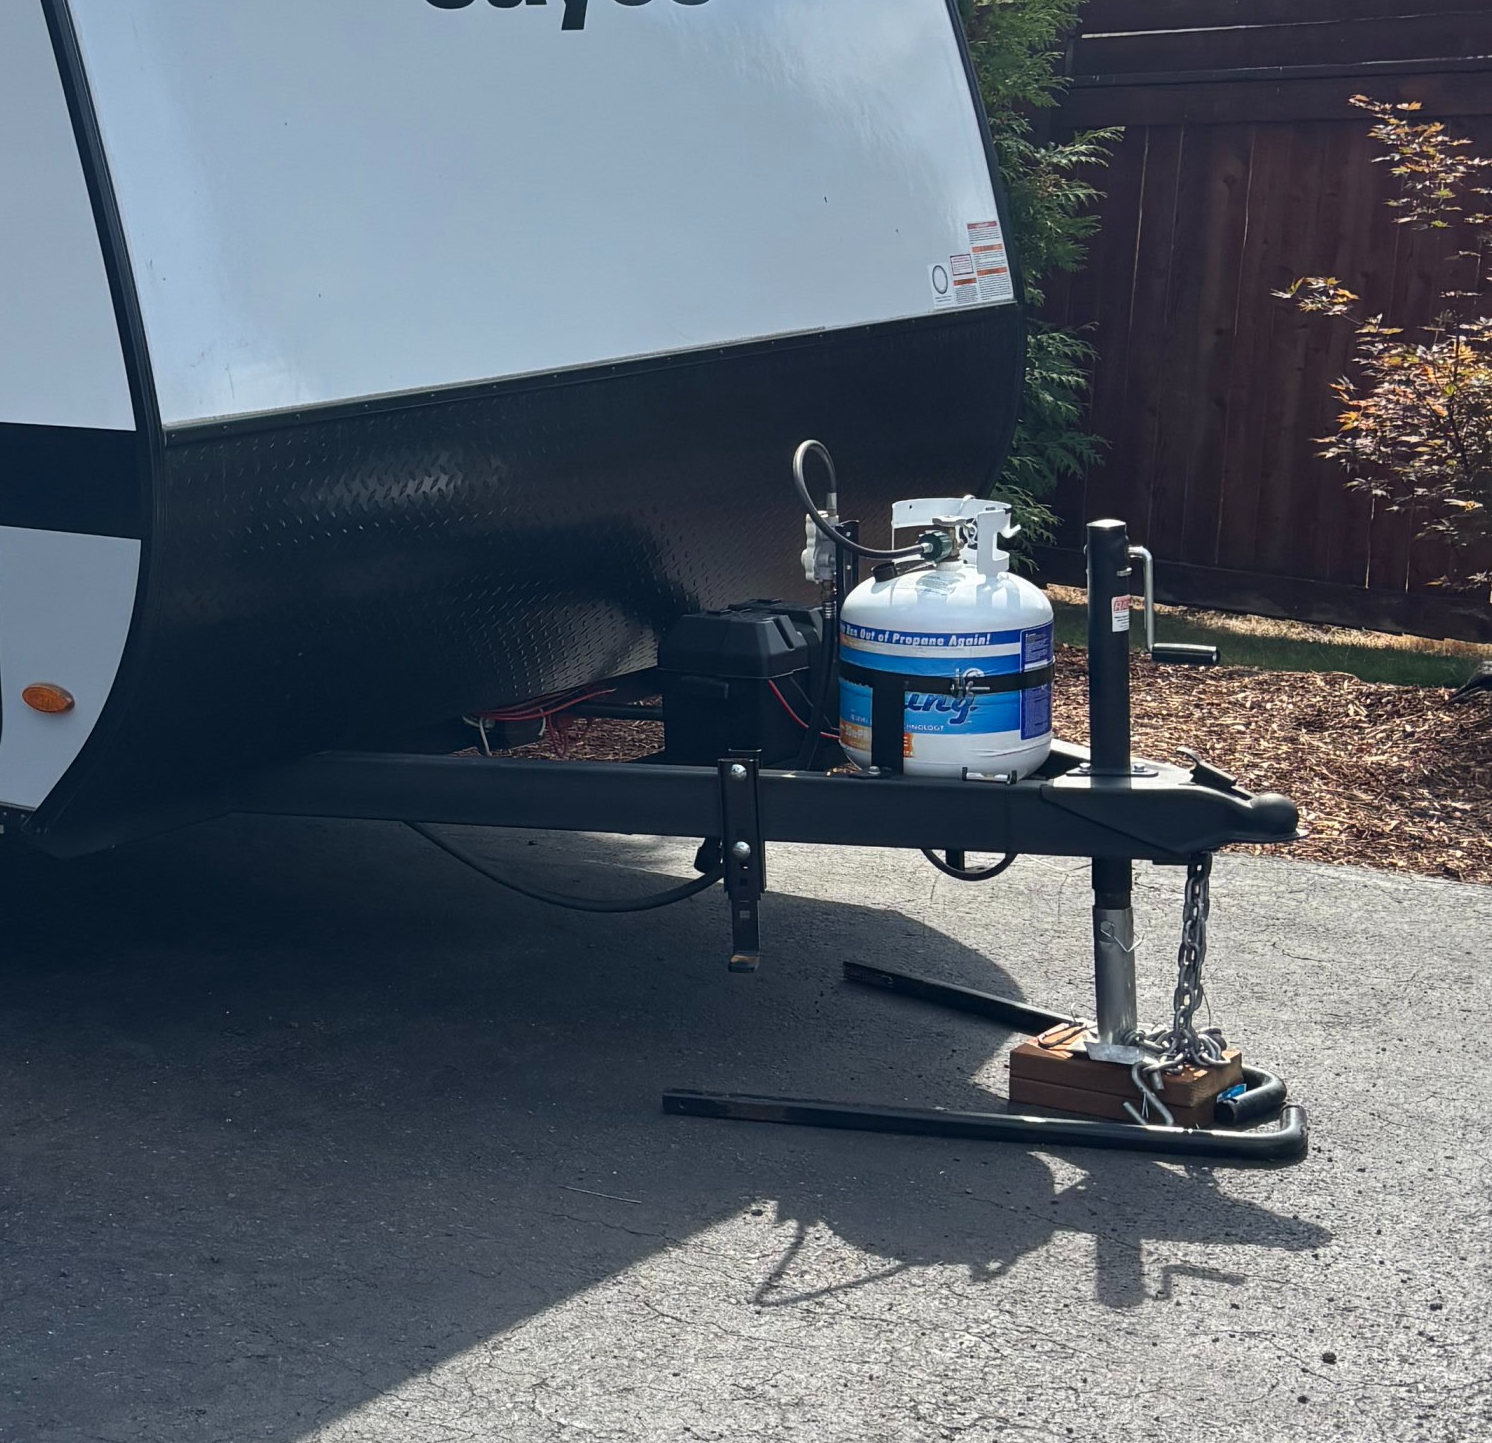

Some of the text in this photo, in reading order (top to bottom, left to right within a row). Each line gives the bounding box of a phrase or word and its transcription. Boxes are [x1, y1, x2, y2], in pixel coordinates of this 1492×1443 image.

[860, 628, 875, 640] Out
[877, 630, 890, 642] of
[892, 633, 945, 647] Propane
[948, 632, 992, 647] Again!
